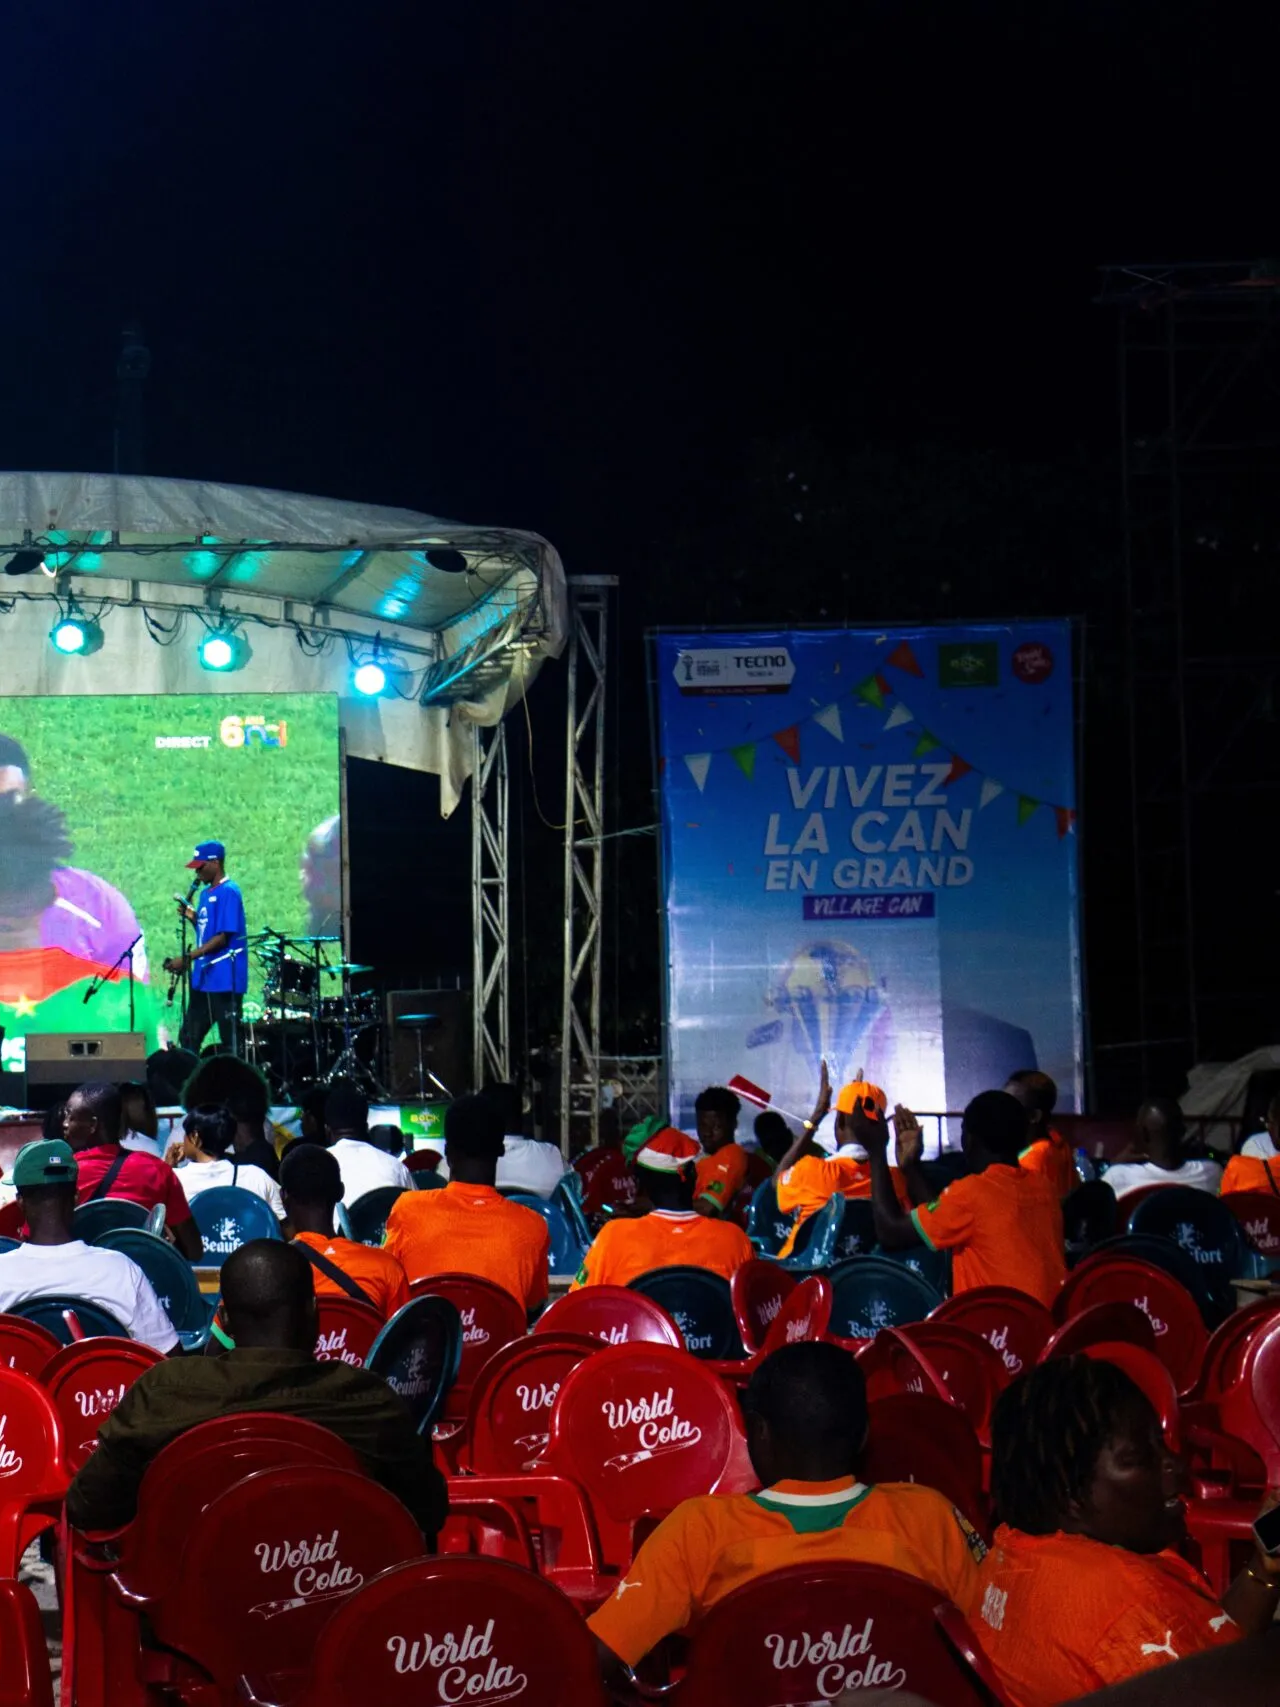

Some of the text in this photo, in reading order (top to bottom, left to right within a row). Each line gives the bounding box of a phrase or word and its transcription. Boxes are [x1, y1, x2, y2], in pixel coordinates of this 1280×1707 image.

[734, 655, 787, 668] TECNO
[155, 735, 211, 748] DIRECT
[786, 762, 953, 810] VIVEZ
[763, 808, 973, 856] LA CAN
[764, 856, 975, 892] EN GRAND
[813, 894, 924, 917] VILLAGE CAN
[601, 1387, 674, 1429] World
[638, 1414, 702, 1449] Cola
[293, 1560, 364, 1597] Cola
[386, 1618, 496, 1674] World
[763, 1617, 875, 1670] World
[437, 1656, 529, 1703] Cola
[816, 1654, 908, 1698] Cola
